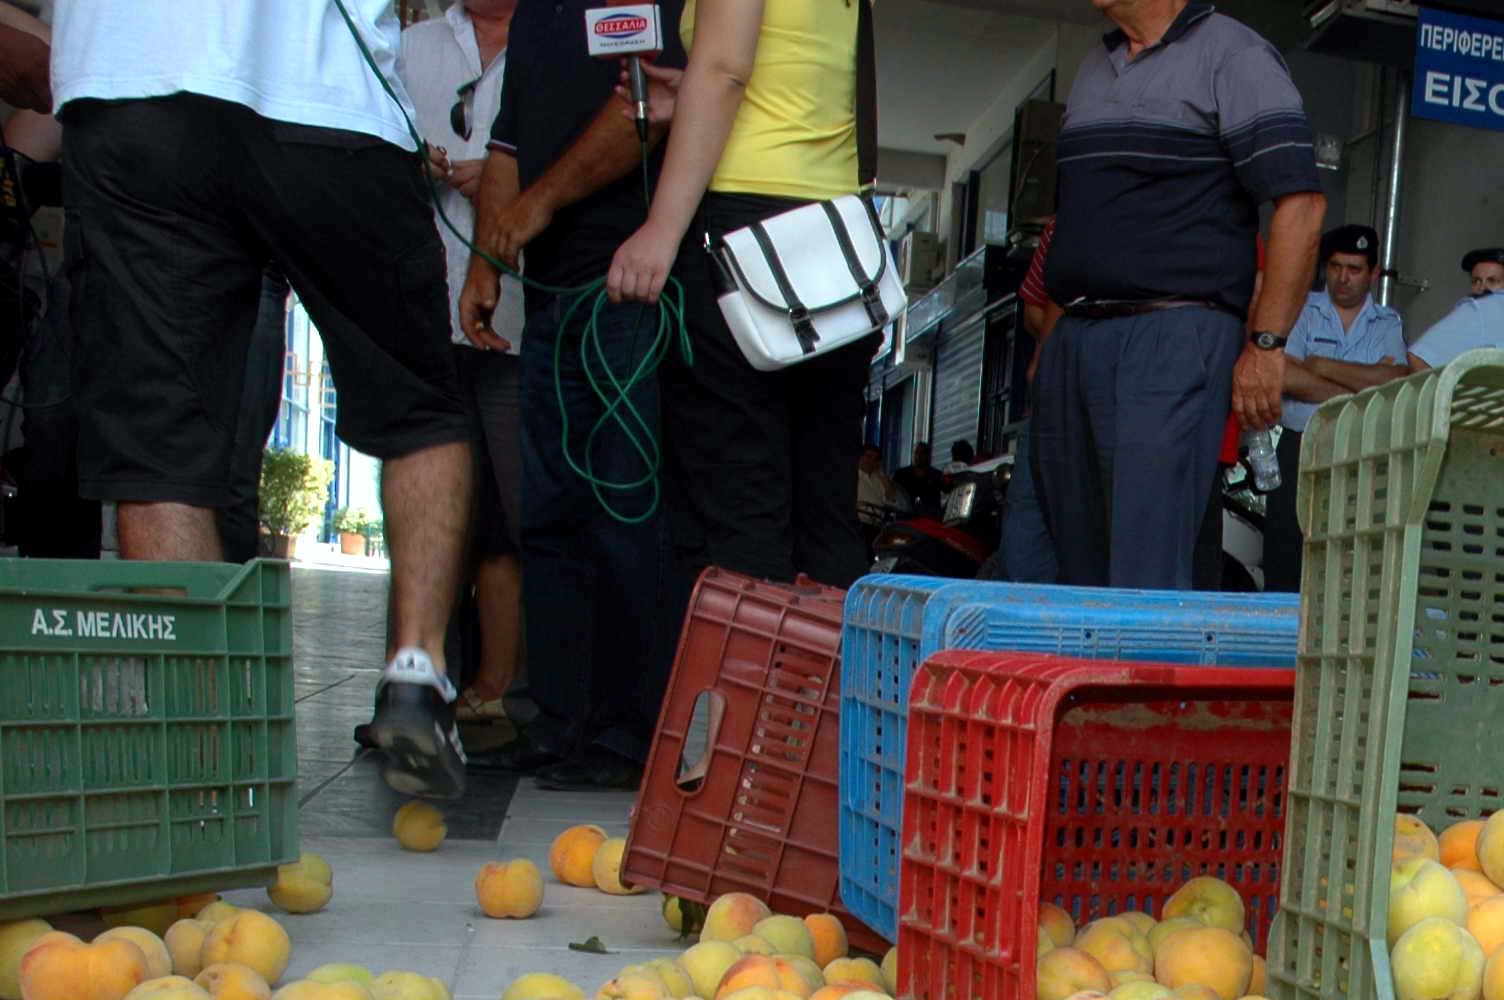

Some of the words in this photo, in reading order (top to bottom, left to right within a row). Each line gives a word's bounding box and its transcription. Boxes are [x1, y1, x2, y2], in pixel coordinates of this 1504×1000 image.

[595, 19, 646, 33] ΘΕΣΣΑΛΙΑ
[31, 607, 73, 636] Α.Σ.
[76, 610, 177, 641] ΜΕΛΙΚΗΣ
